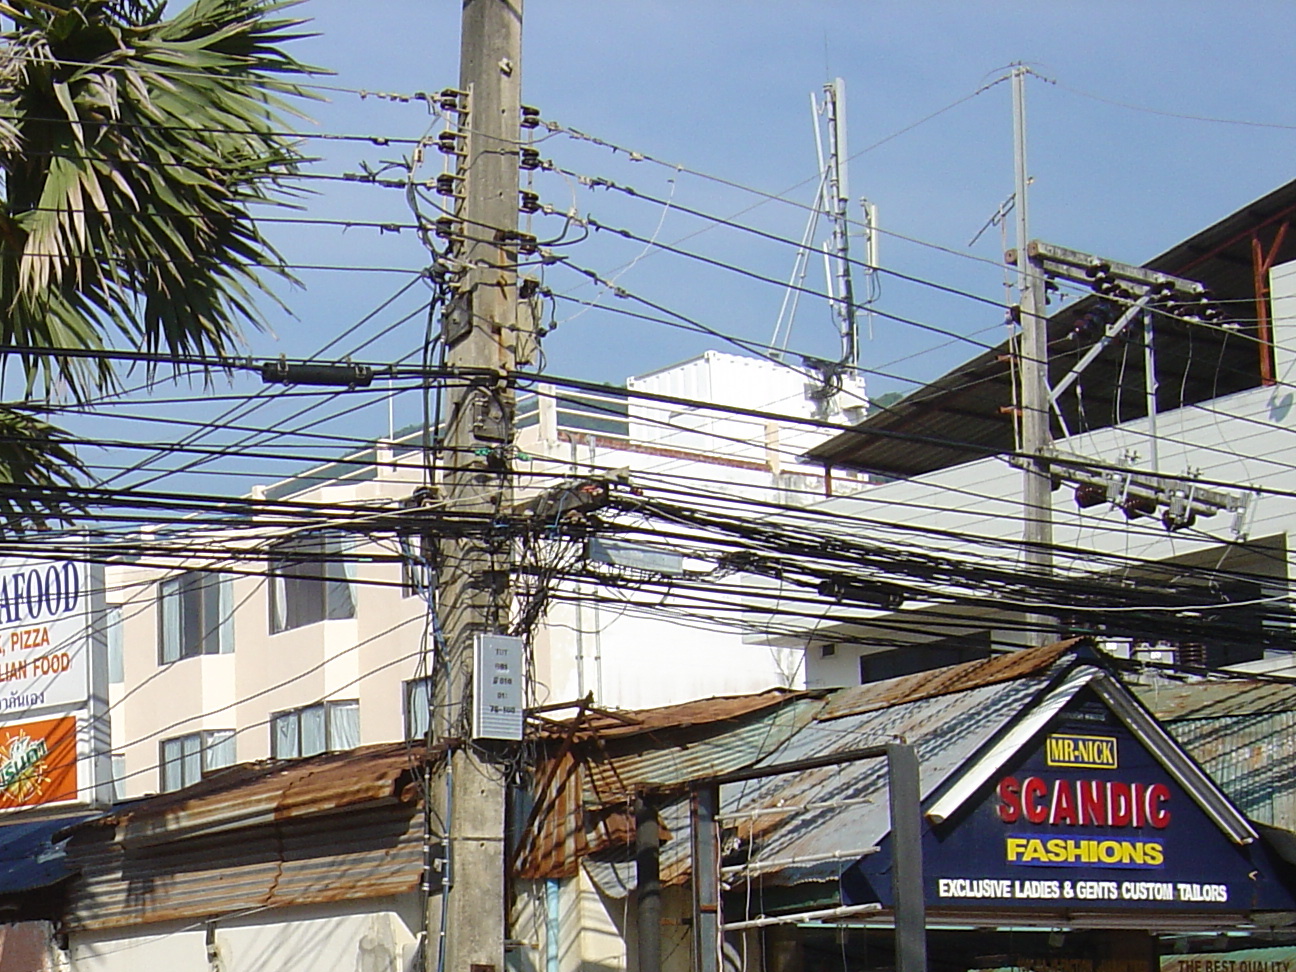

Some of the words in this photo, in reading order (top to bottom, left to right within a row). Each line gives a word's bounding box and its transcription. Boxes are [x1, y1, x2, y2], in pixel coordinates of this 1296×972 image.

[10, 627, 50, 652] PIZZA
[32, 652, 70, 678] FOOD
[1049, 737, 1115, 765] MR-NICK
[997, 776, 1172, 828] SCANDIC
[1006, 837, 1164, 867] FASHIONS
[939, 878, 1011, 898] EXCLUSIVE
[1014, 880, 1059, 899] LADIES
[1063, 881, 1075, 899] &
[1076, 881, 1118, 900] GENTS
[1121, 882, 1173, 901] CUSTOM
[1177, 883, 1228, 902] TAILORS
